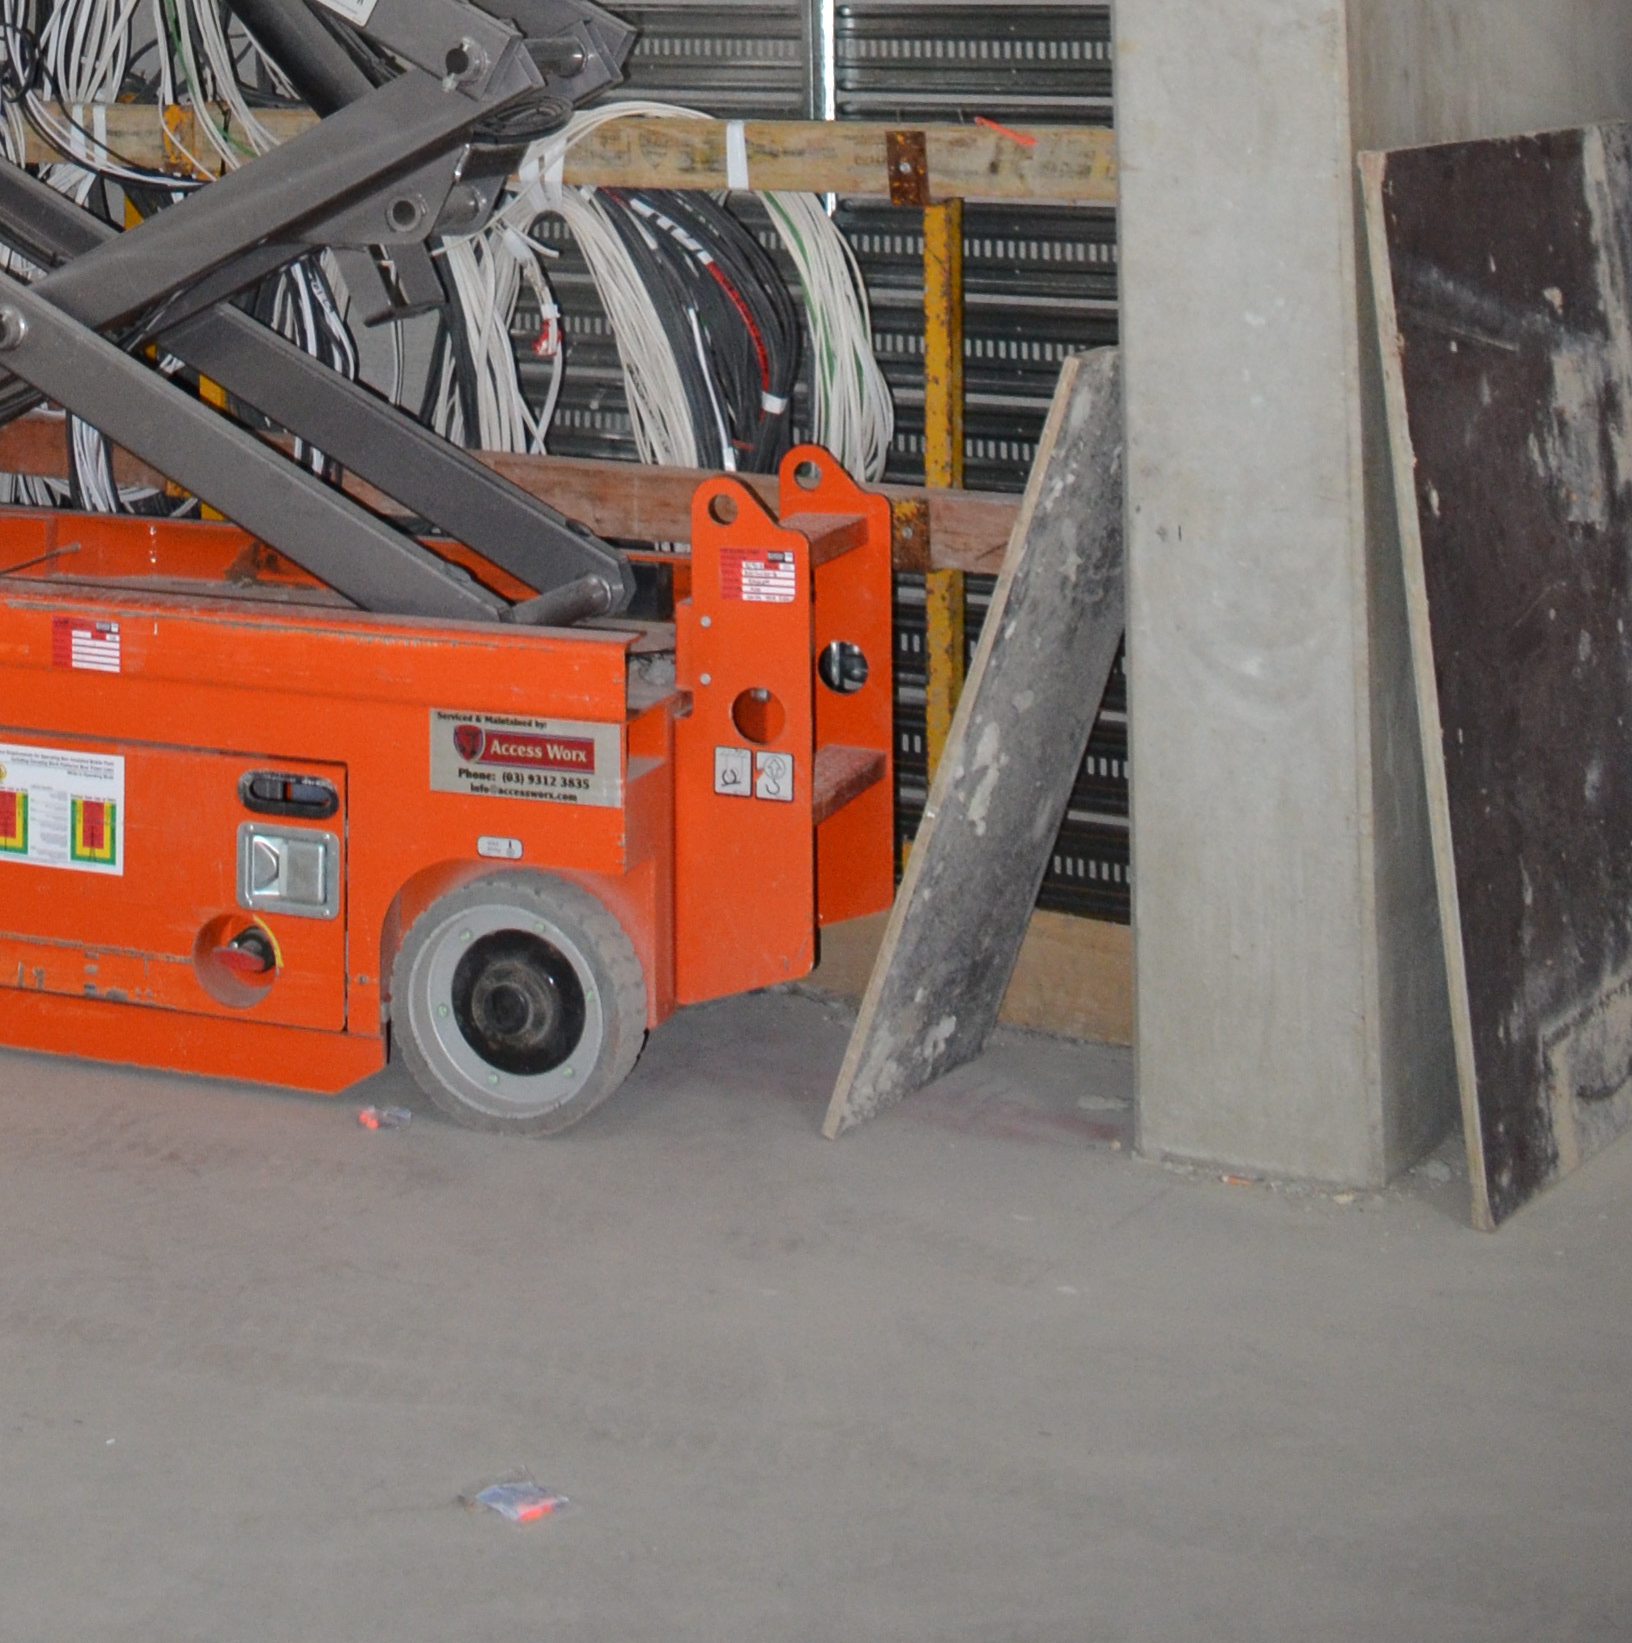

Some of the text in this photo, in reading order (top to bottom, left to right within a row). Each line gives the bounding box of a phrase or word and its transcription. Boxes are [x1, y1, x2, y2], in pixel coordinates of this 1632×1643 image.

[437, 711, 473, 723] Serviced
[484, 716, 533, 728] Maintained
[489, 737, 587, 763] Access Worx
[458, 767, 496, 782] Phone:
[502, 770, 524, 786] (03)
[527, 773, 557, 787] 9312
